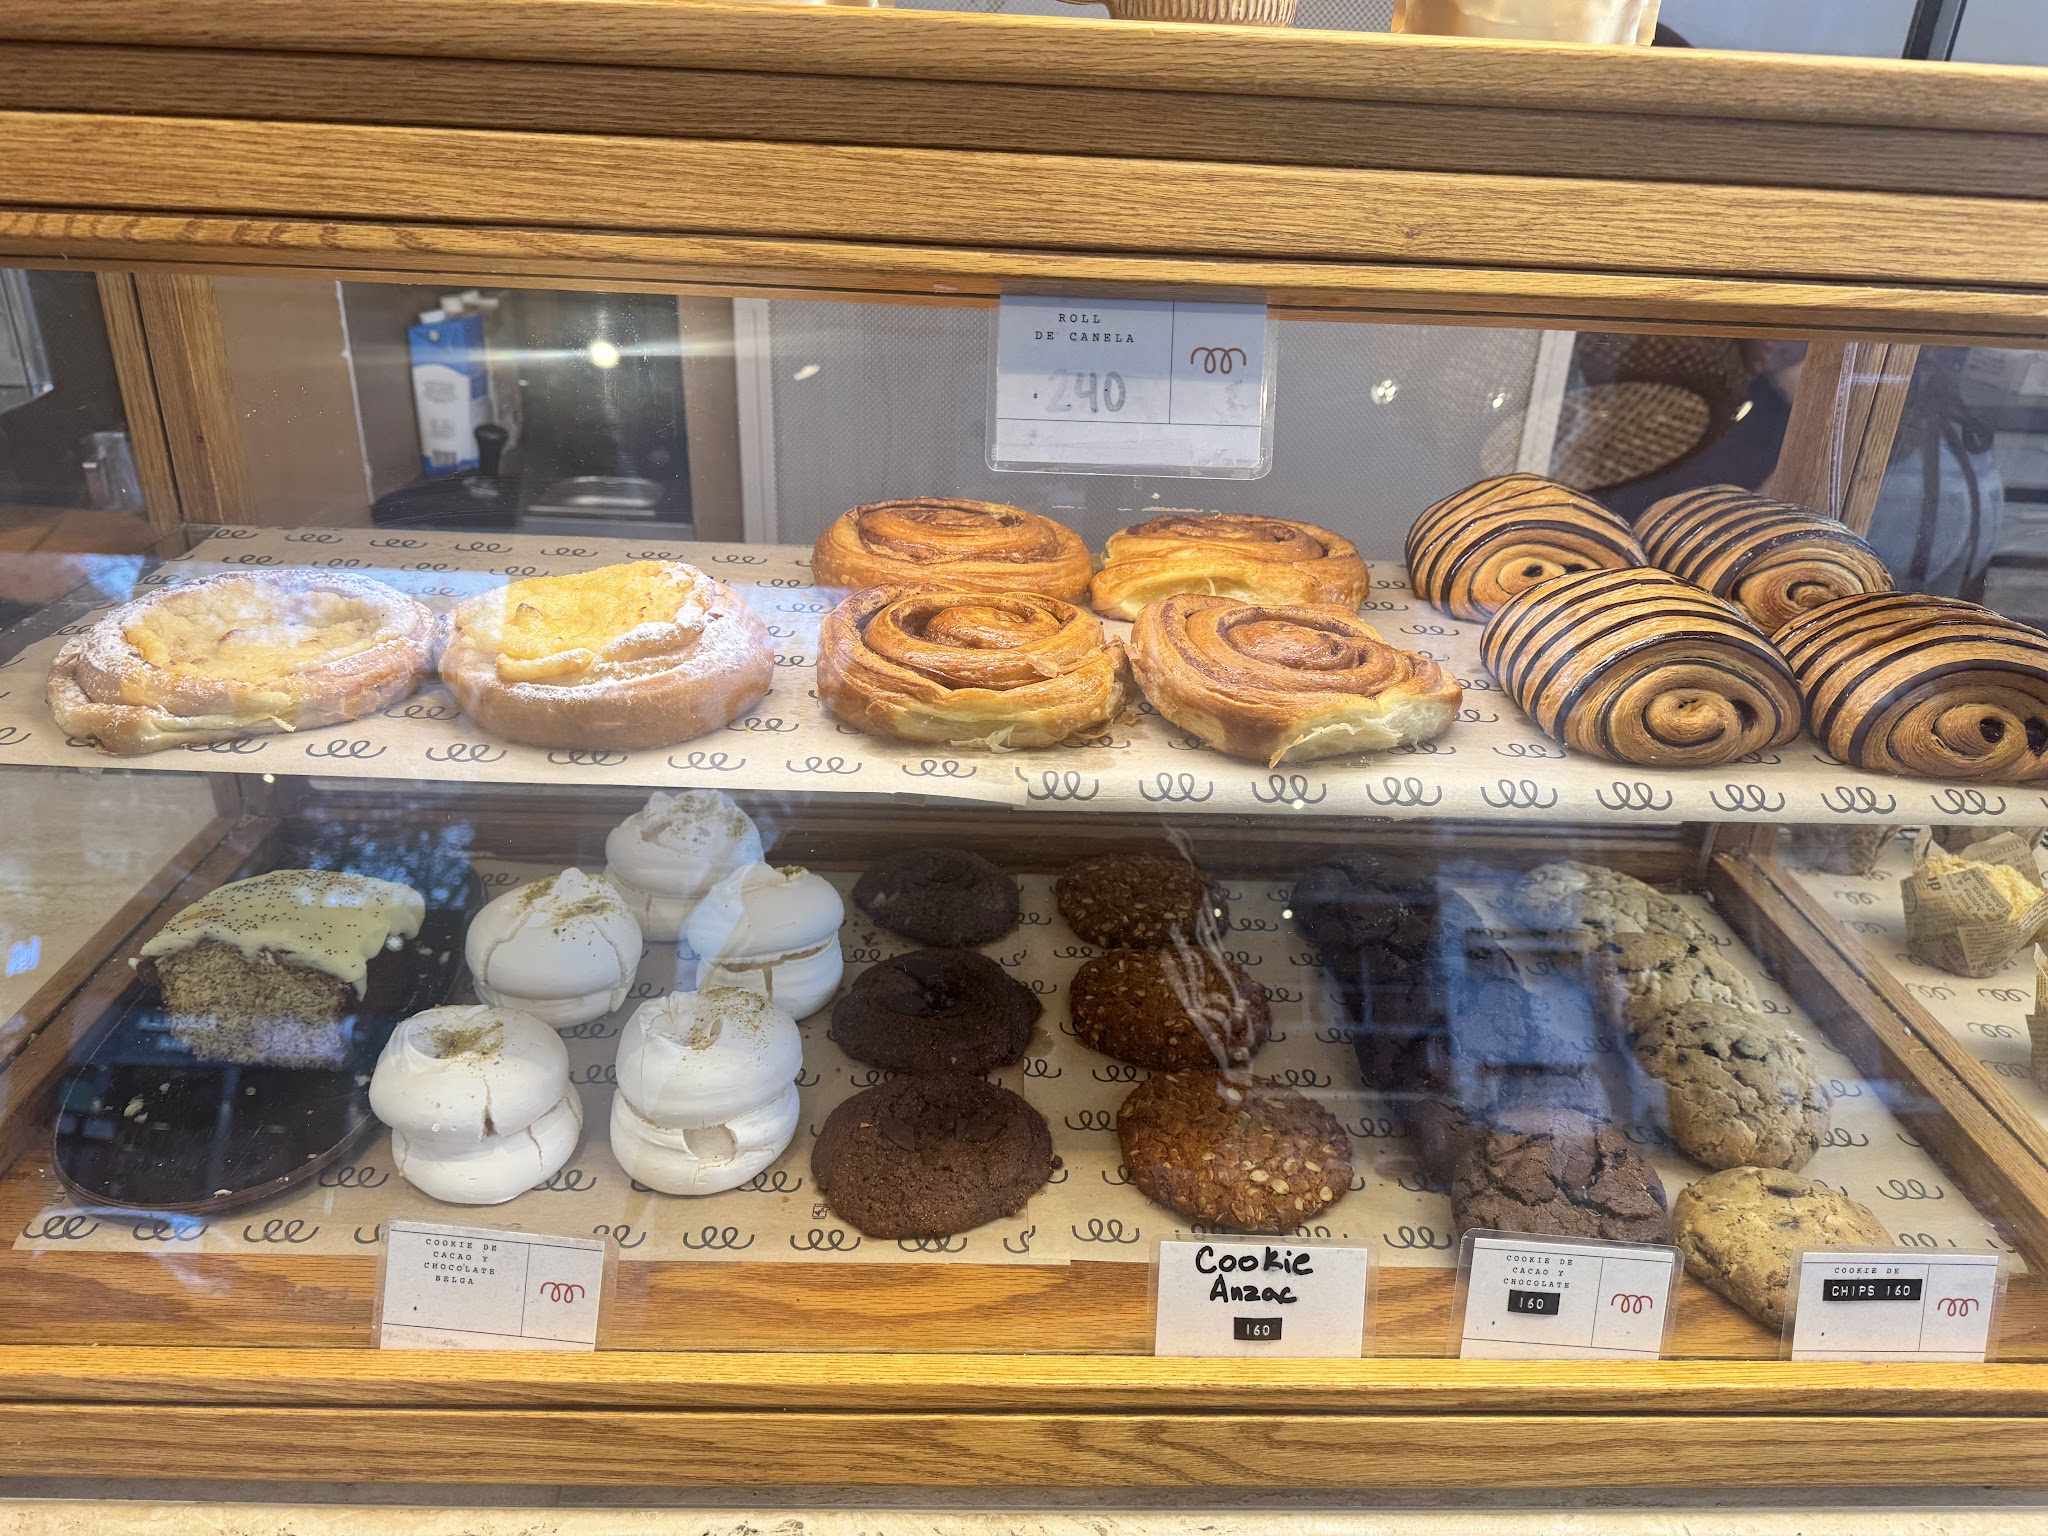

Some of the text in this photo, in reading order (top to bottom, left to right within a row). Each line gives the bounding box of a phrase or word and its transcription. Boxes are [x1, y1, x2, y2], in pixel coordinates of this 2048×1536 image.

[1058, 313, 1101, 325] ROLL
[1034, 330, 1135, 344] DE CANELA
[1047, 368, 1127, 414] 240
[425, 1238, 498, 1252] COOKIE DE
[433, 1251, 489, 1263] CACAO Y
[1195, 1246, 1314, 1276] Cookie
[1506, 1255, 1574, 1266] COOKIE DE
[424, 1262, 496, 1275] CHOCOLATE
[1512, 1267, 1549, 1276] CACAO
[1834, 1267, 1878, 1275] COOKIE
[435, 1275, 475, 1286] BELGA
[1503, 1278, 1570, 1289] CHOCOLATE
[1209, 1273, 1298, 1304] Anzac
[1831, 1285, 1911, 1297] CHIPS 160
[1519, 1297, 1544, 1310] 160
[1246, 1323, 1271, 1336] 160
